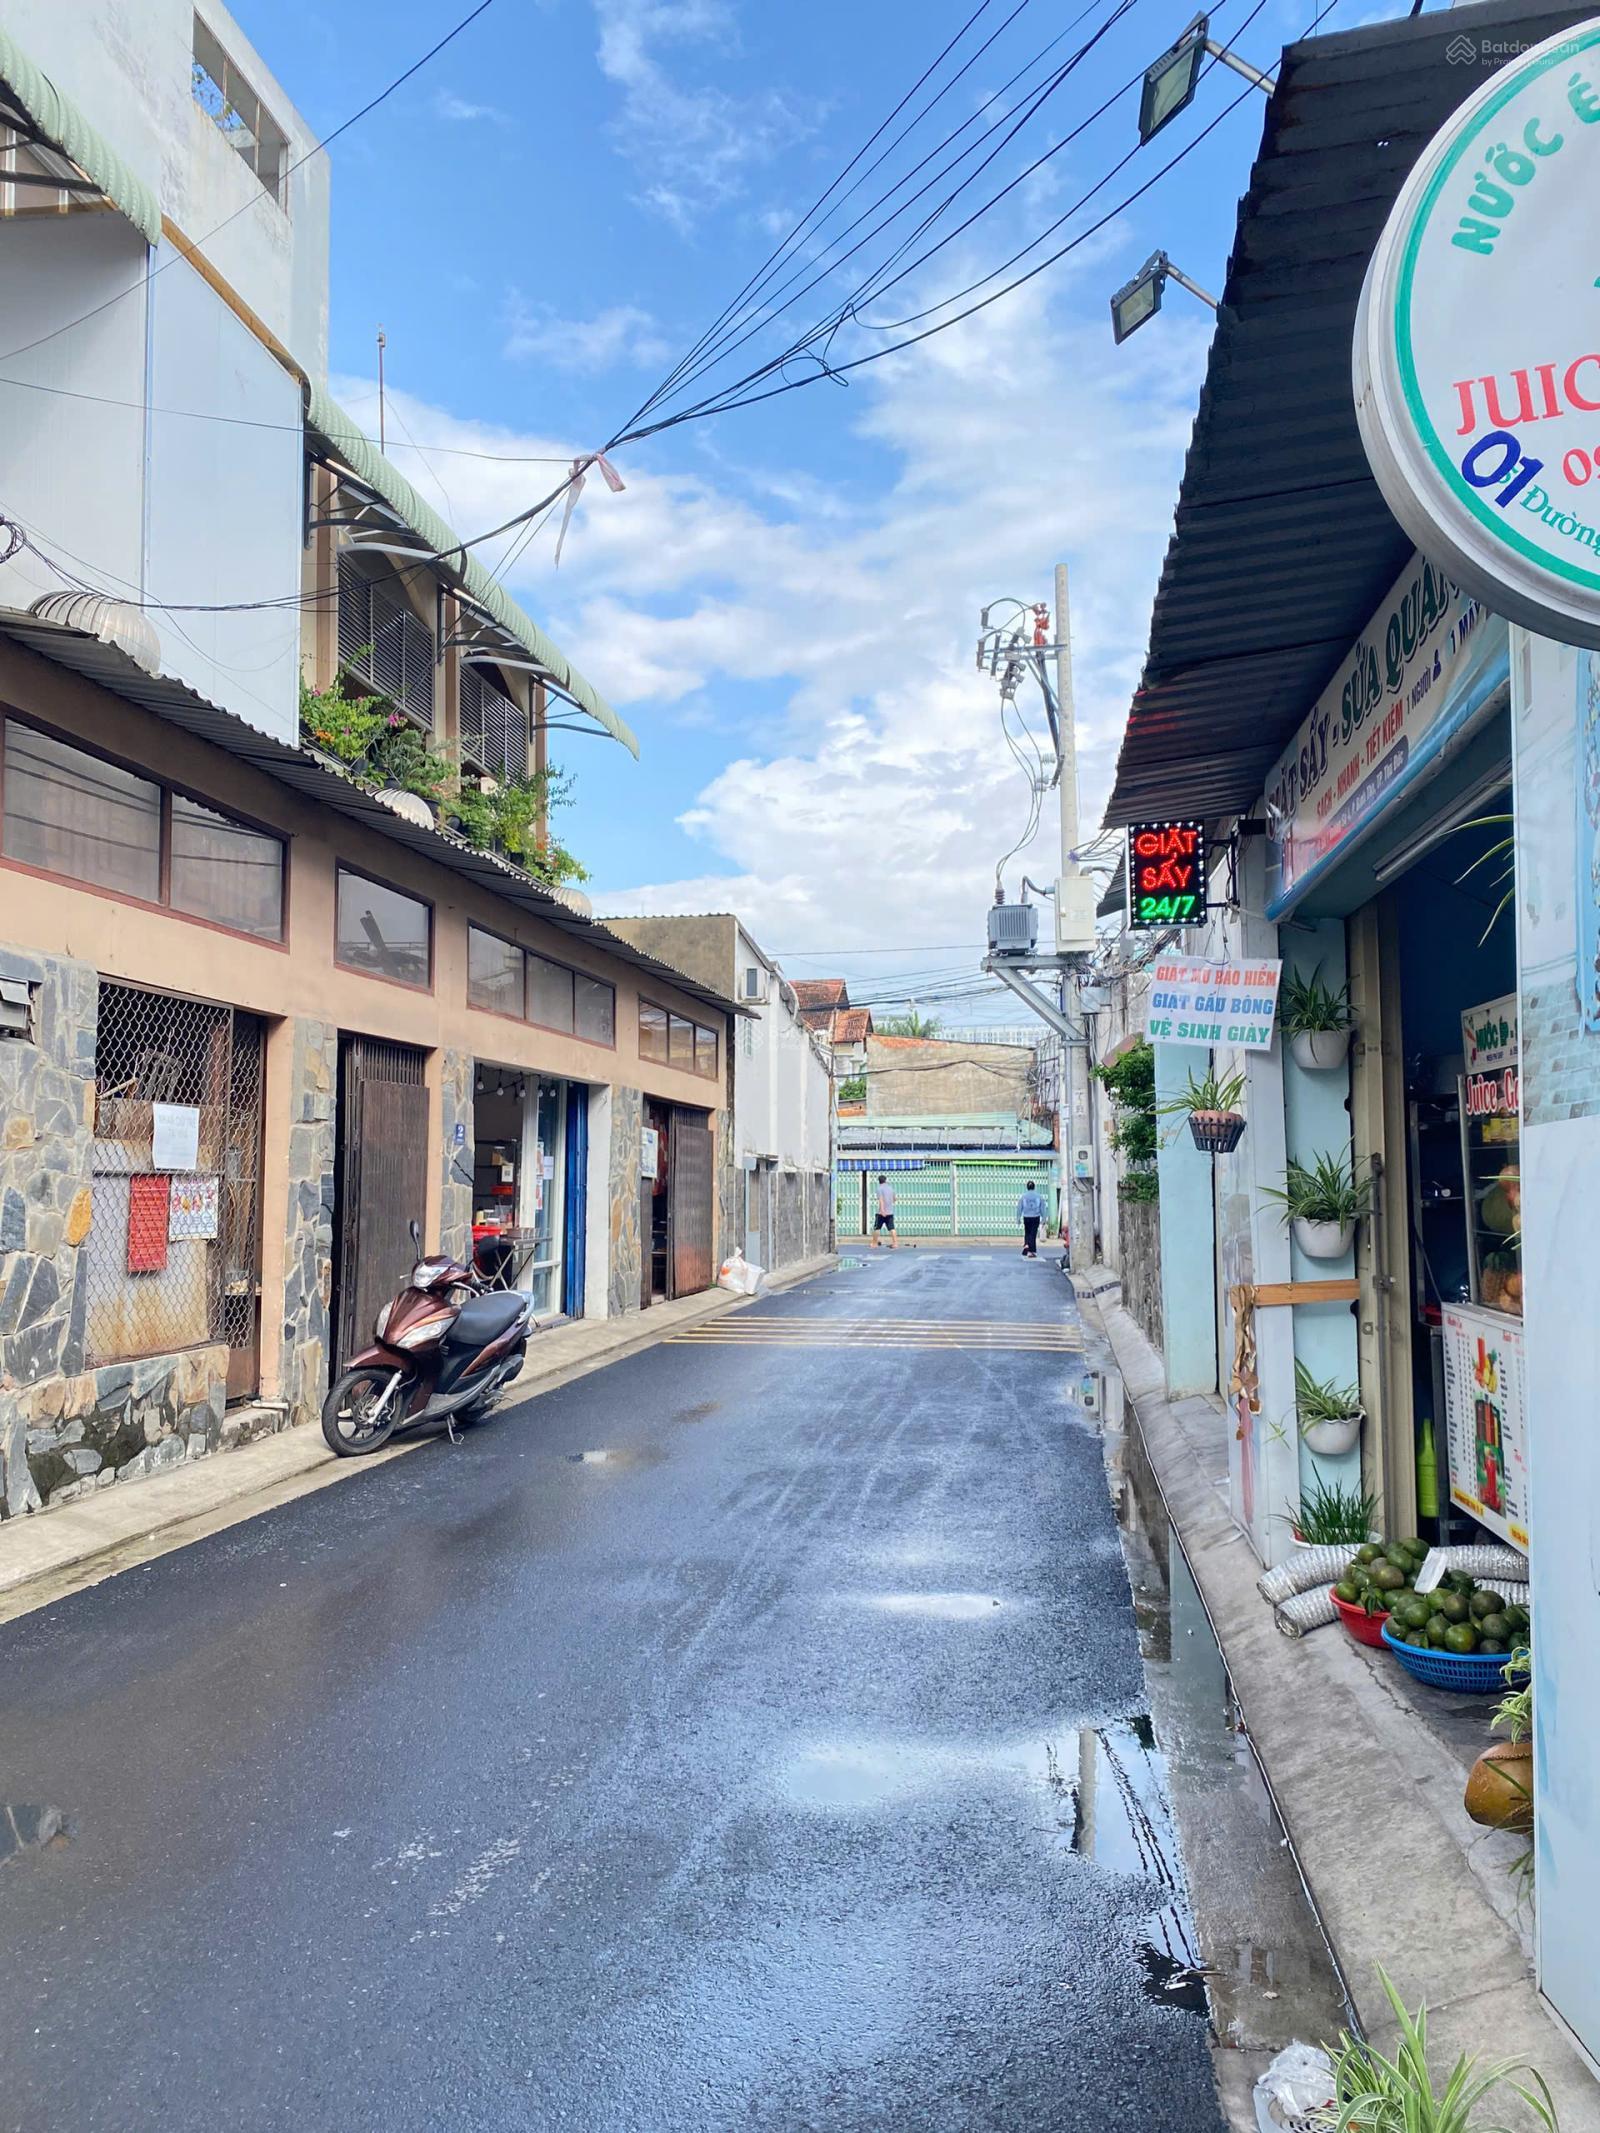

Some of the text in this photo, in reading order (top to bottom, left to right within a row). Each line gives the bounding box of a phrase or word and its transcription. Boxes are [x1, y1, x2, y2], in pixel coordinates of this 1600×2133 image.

[1451, 117, 1564, 255] NƯỚC
[1453, 354, 1600, 435] JUIC
[1462, 430, 1544, 508] 01
[1143, 853, 1192, 890] SẤY
[1140, 895, 1196, 918] 24/7
[1195, 991, 1226, 1013] GẤU
[1230, 994, 1274, 1015] BÔNG
[1150, 1017, 1271, 1043] VỆ SINH GIÀY
[1466, 1074, 1497, 1116] Juice
